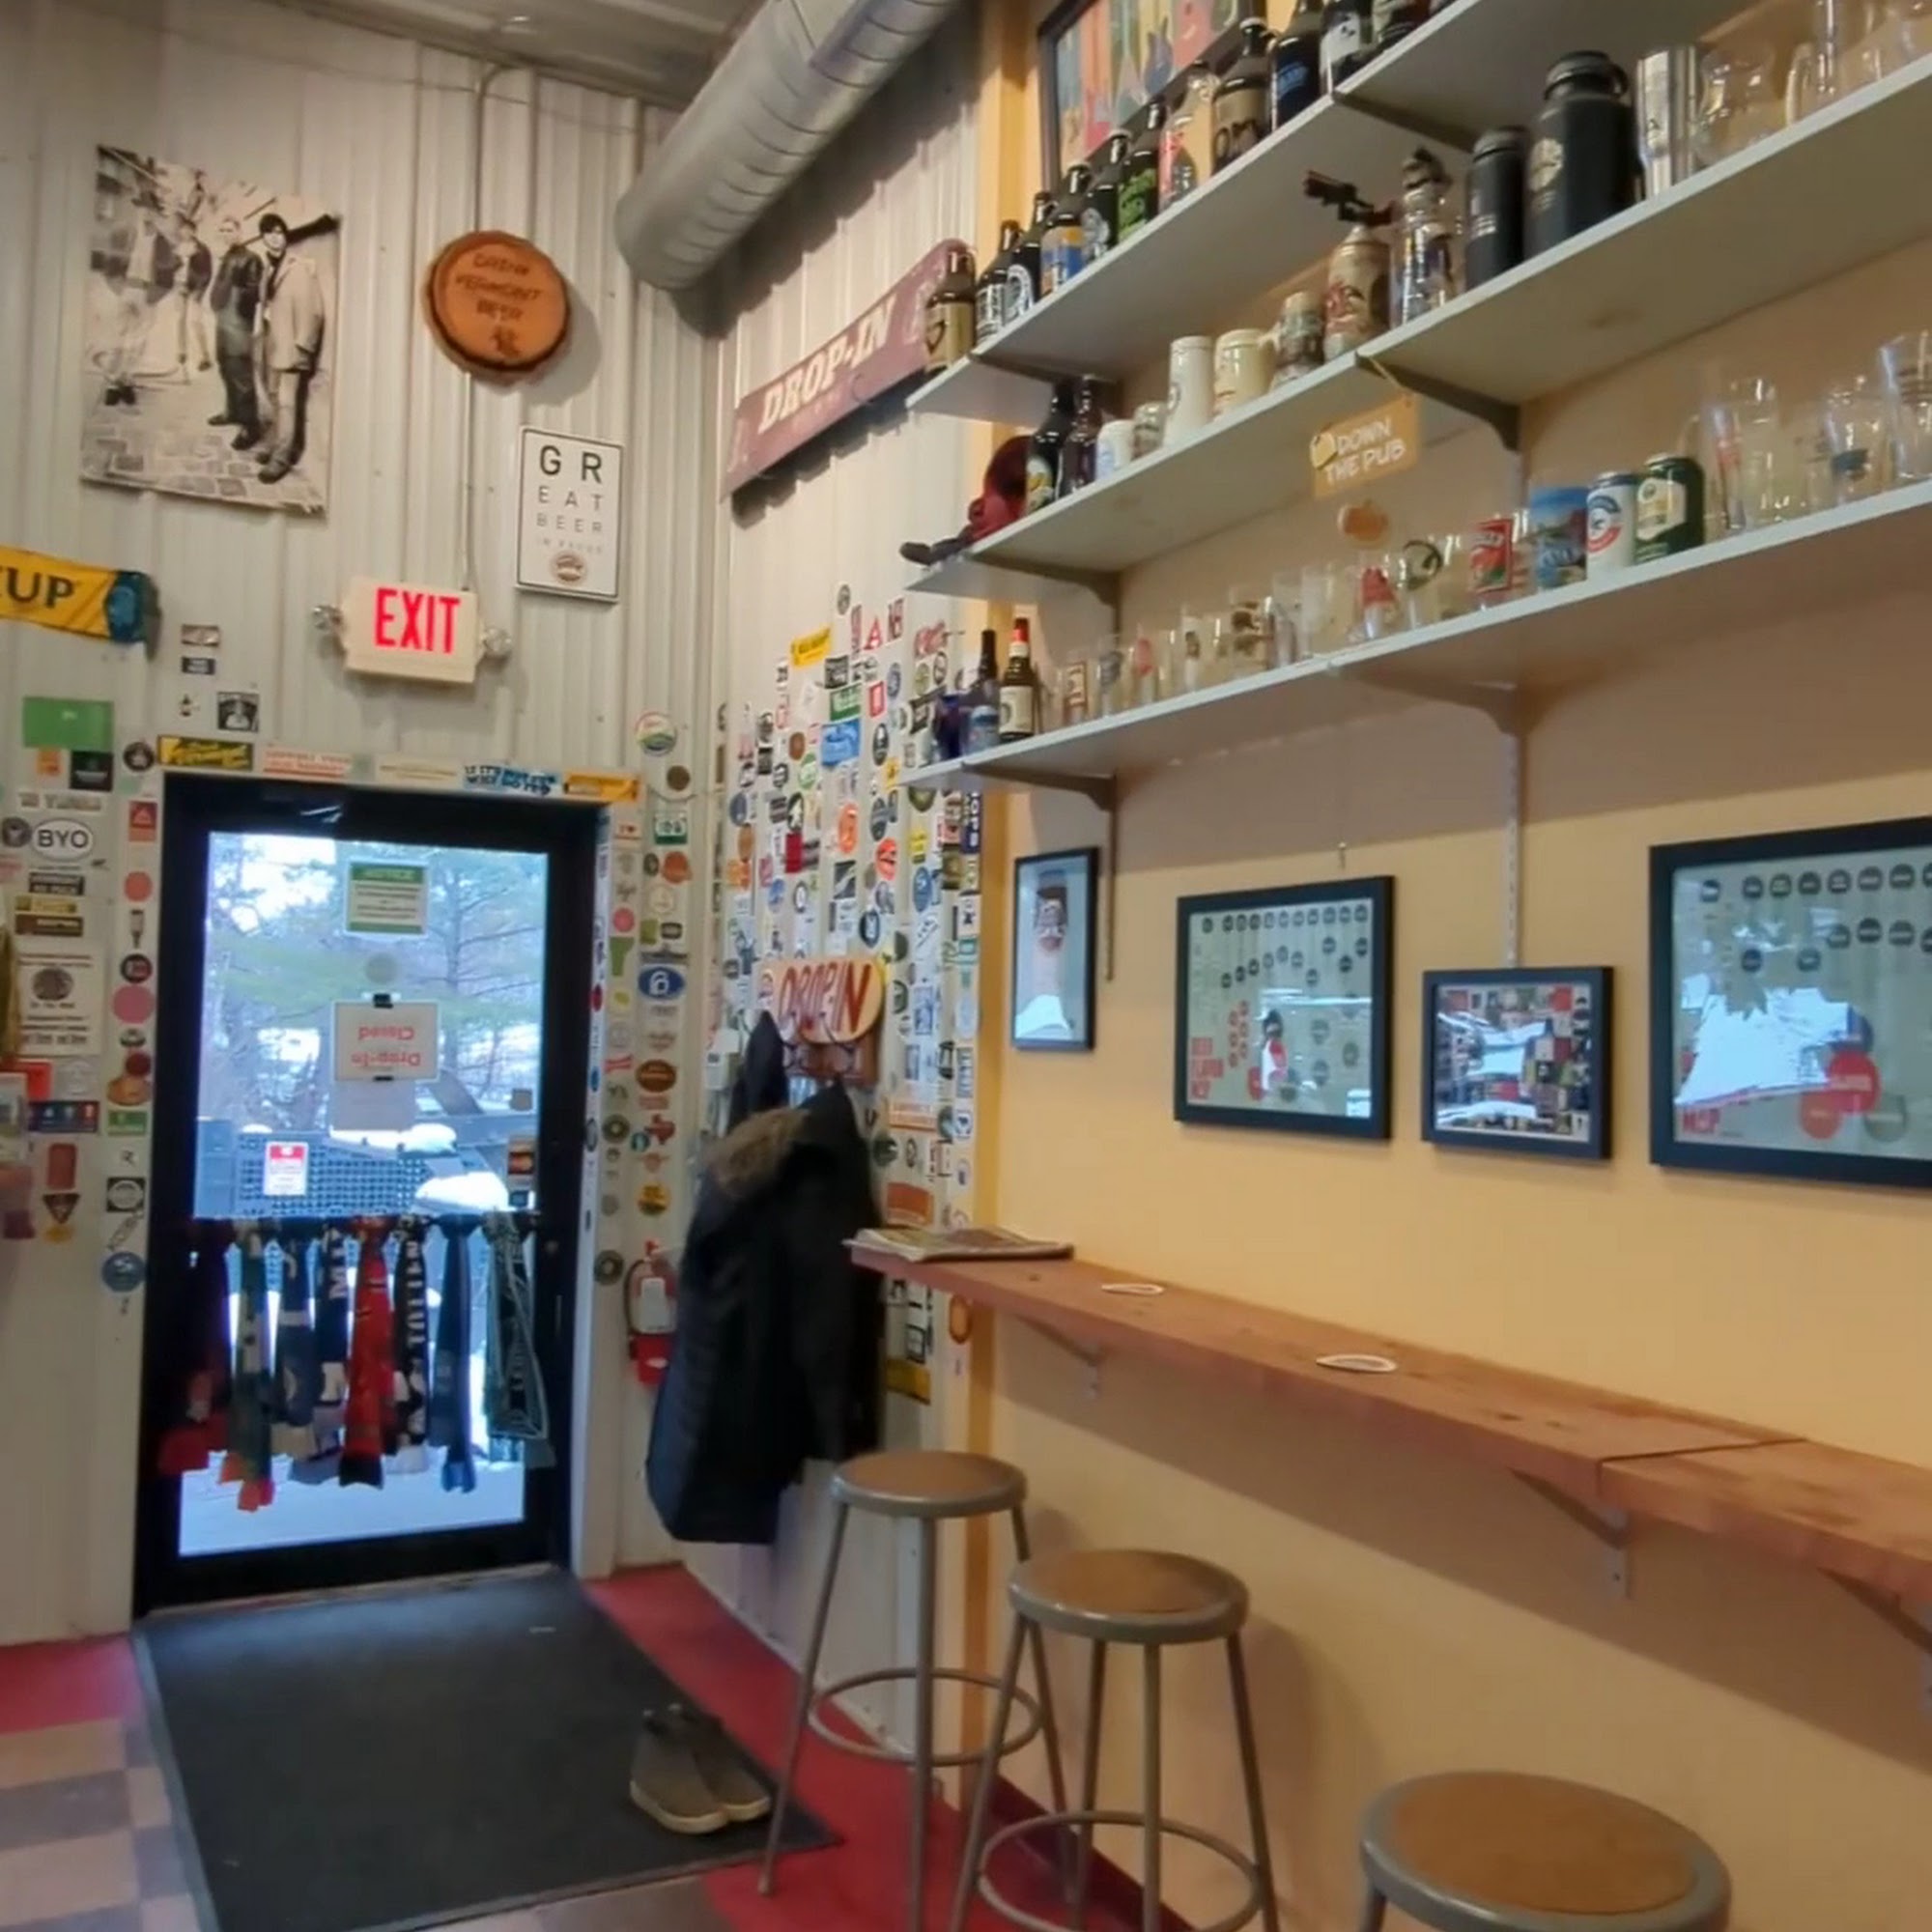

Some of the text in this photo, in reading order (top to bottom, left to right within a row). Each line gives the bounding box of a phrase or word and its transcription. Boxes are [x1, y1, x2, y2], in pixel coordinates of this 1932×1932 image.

[757, 293, 897, 434] DROP-IN
[1337, 417, 1391, 455] DOWN
[1324, 439, 1406, 485] THE PUB
[0, 565, 74, 608] UP
[376, 587, 461, 653] EXIT
[38, 830, 89, 848] BYO
